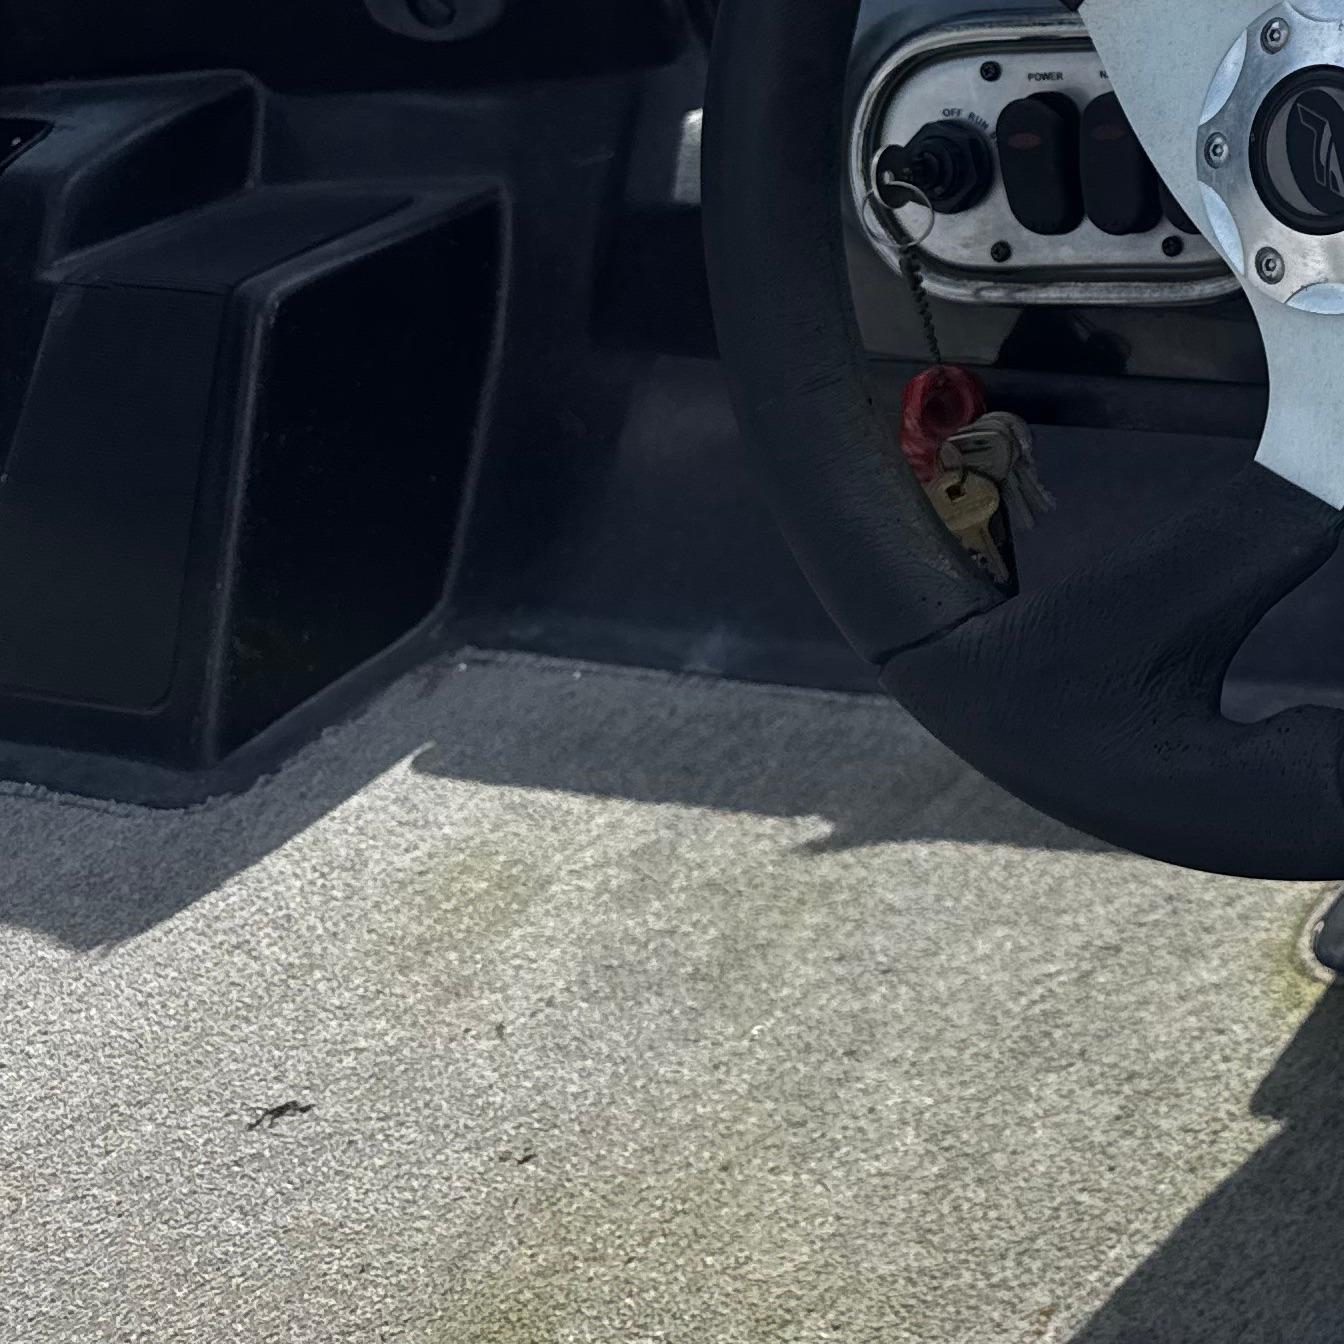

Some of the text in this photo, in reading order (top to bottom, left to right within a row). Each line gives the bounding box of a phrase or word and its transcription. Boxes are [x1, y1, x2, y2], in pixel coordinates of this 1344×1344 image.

[1028, 72, 1064, 81] POWER
[942, 108, 989, 130] OFF RUN
